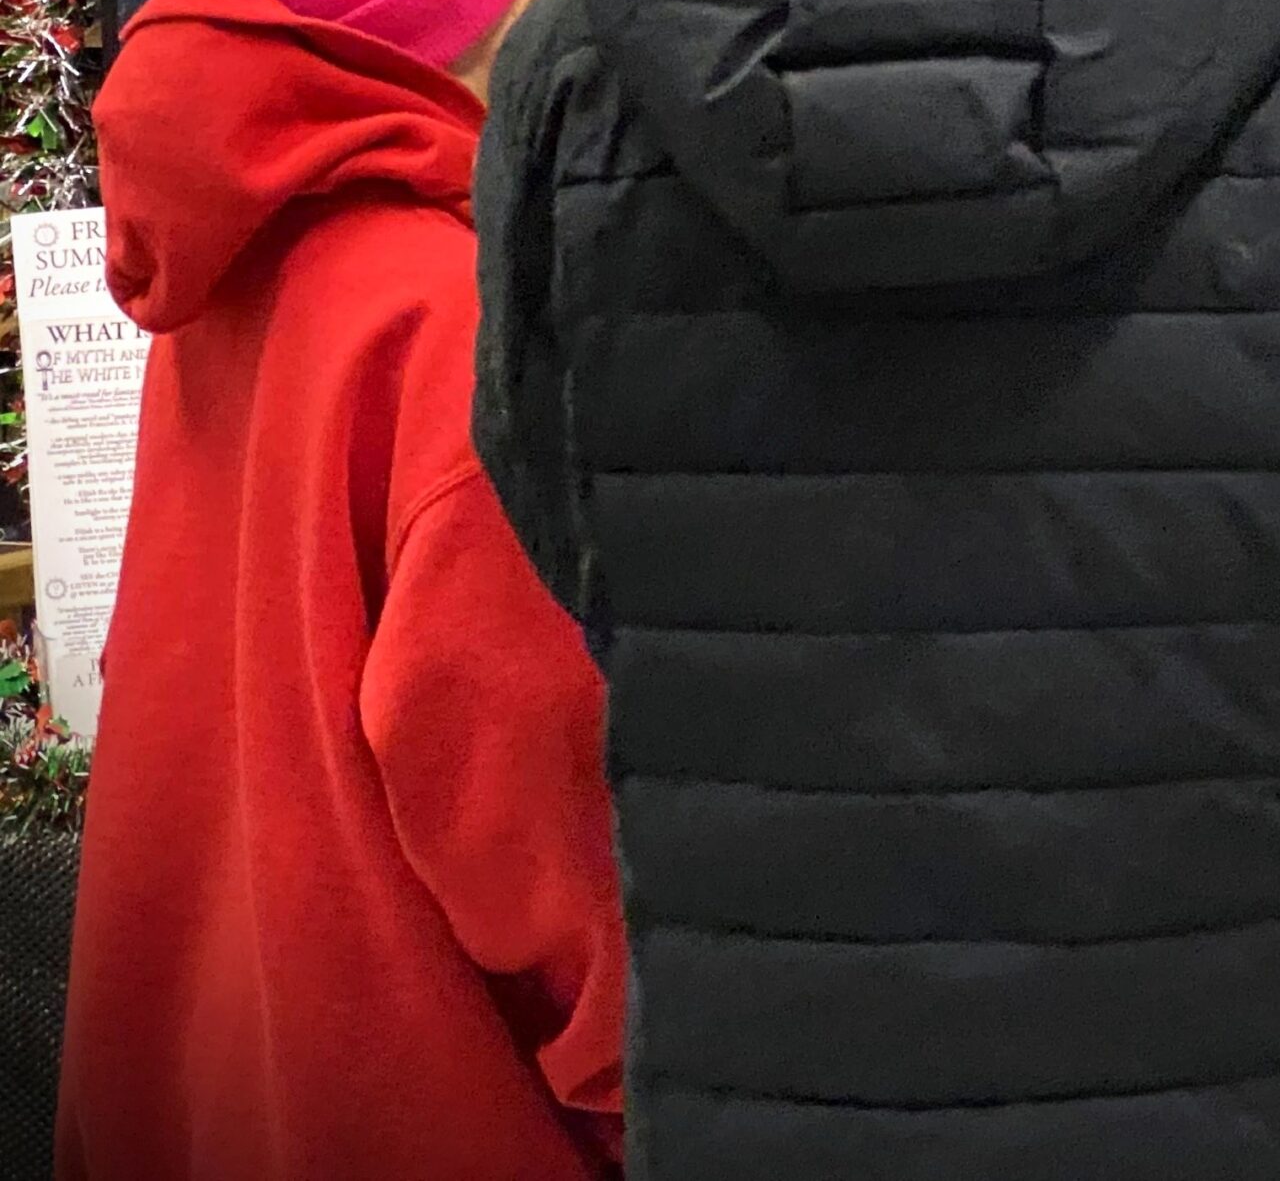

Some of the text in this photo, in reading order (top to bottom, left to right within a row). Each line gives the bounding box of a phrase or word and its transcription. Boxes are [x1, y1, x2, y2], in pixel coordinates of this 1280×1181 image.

[72, 221, 107, 240] FR
[29, 276, 90, 298] Please
[47, 322, 128, 344] WHAT
[66, 349, 114, 365] MYTH
[79, 366, 131, 383] WHITE
